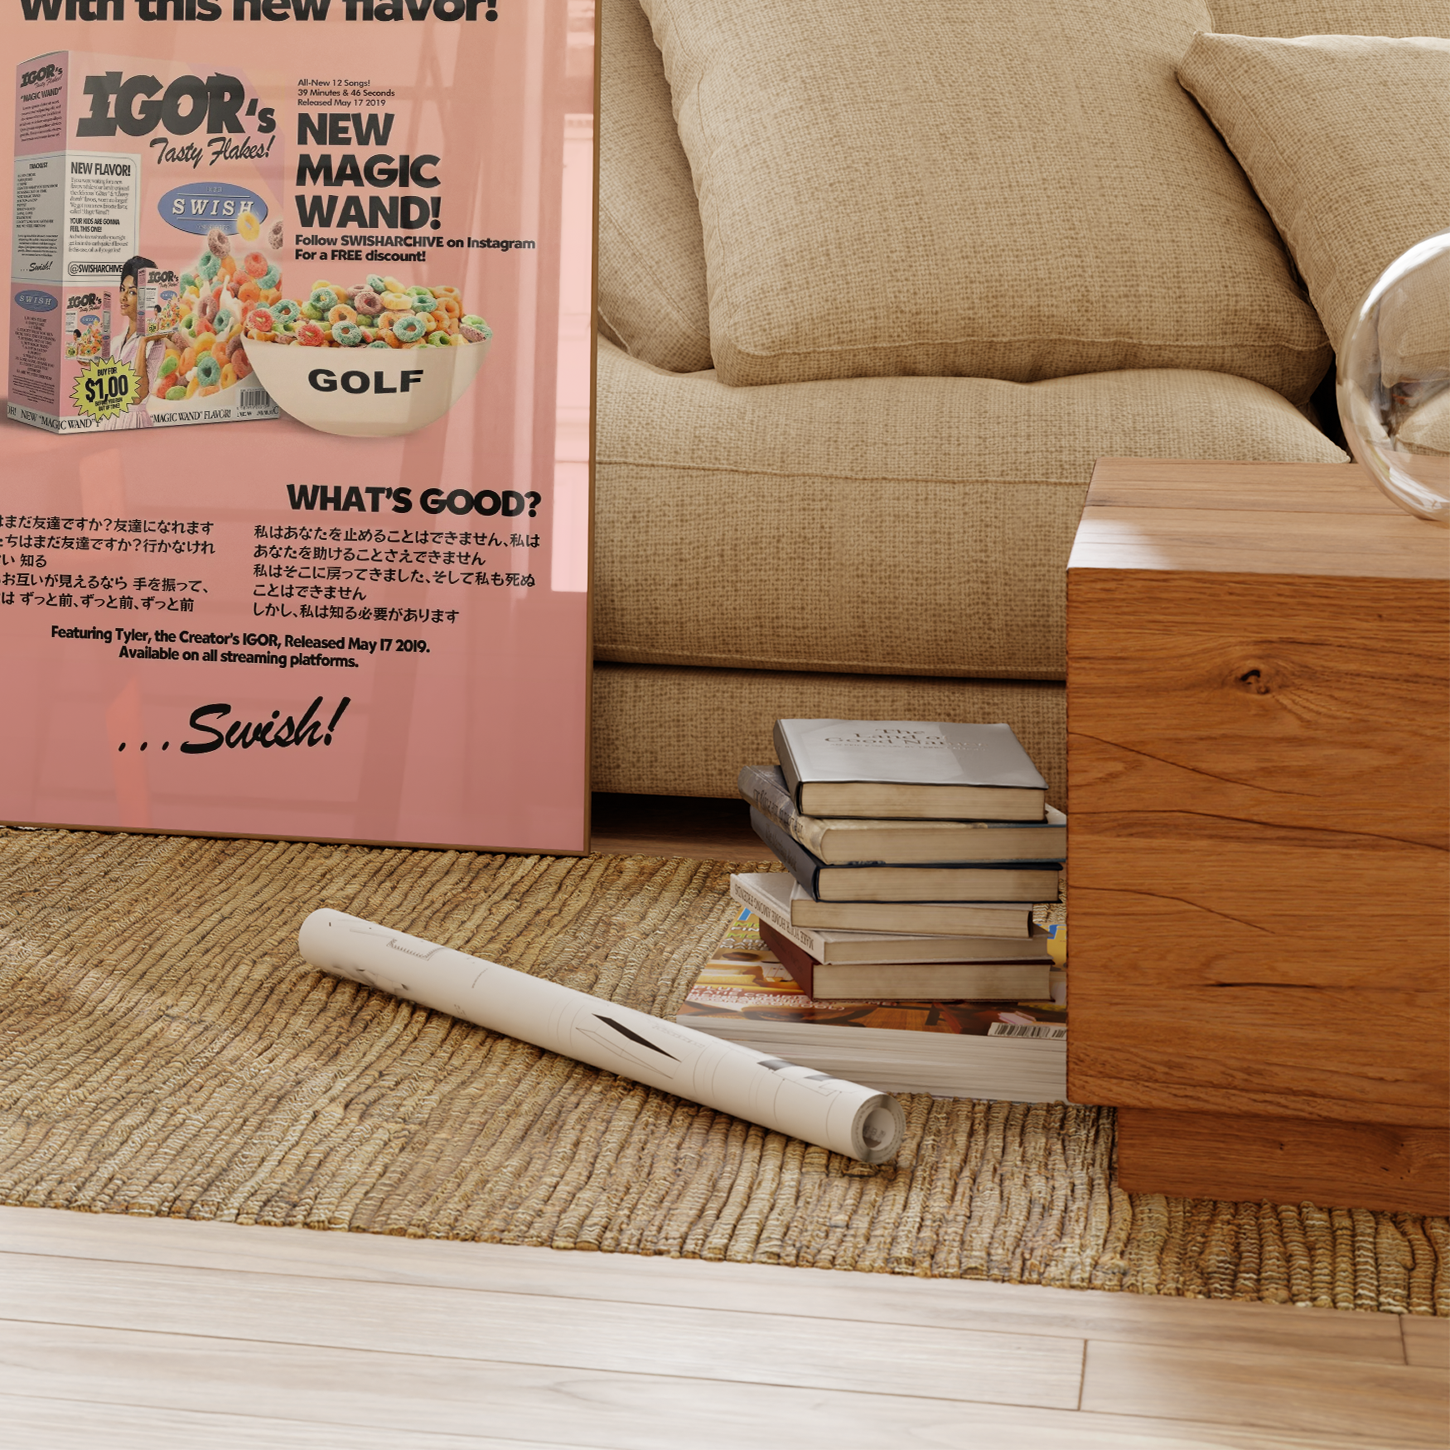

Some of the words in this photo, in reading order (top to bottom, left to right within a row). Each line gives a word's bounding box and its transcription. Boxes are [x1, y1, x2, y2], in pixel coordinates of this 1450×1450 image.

[298, 79, 330, 87] All-New
[344, 79, 370, 89] Songs!
[363, 89, 395, 97] Seconds
[76, 71, 276, 137] IGOR's
[334, 99, 351, 108] May
[297, 113, 395, 146] NEW
[150, 137, 203, 169] Tasty
[208, 135, 276, 164] Flakes!
[71, 162, 93, 175] NEW
[95, 163, 131, 177] FLAVOR!
[296, 154, 441, 188] MAGIC
[172, 198, 253, 217] SWISH
[295, 194, 441, 230] WAND!
[295, 235, 338, 246] Follow
[341, 235, 443, 248] SWISHARCHIVE
[447, 239, 464, 248] on
[467, 237, 535, 252] Instagram
[295, 249, 317, 260] For
[319, 252, 327, 260] a
[331, 250, 362, 260] FREE
[365, 250, 426, 262] discount!
[19, 295, 52, 305] SWISH
[308, 368, 424, 394] GOLF
[21, 408, 38, 422] NEW
[287, 484, 413, 513] WHAT'S
[420, 488, 542, 518] GOOD?
[20, 553, 47, 568] 知る
[253, 584, 367, 601] ことはできません
[51, 626, 112, 643] Featuring
[116, 628, 151, 644] Tyler,
[154, 630, 176, 643] the
[180, 631, 239, 645] Creator's
[243, 633, 282, 648] IGOR,
[285, 635, 345, 650] Released
[348, 638, 377, 654] May
[380, 639, 393, 651] 17
[395, 639, 430, 653] 2019.
[119, 645, 179, 660] Available
[182, 649, 200, 661] on
[202, 648, 217, 662] all
[220, 650, 287, 668] streaming
[290, 652, 359, 668] platforms.
